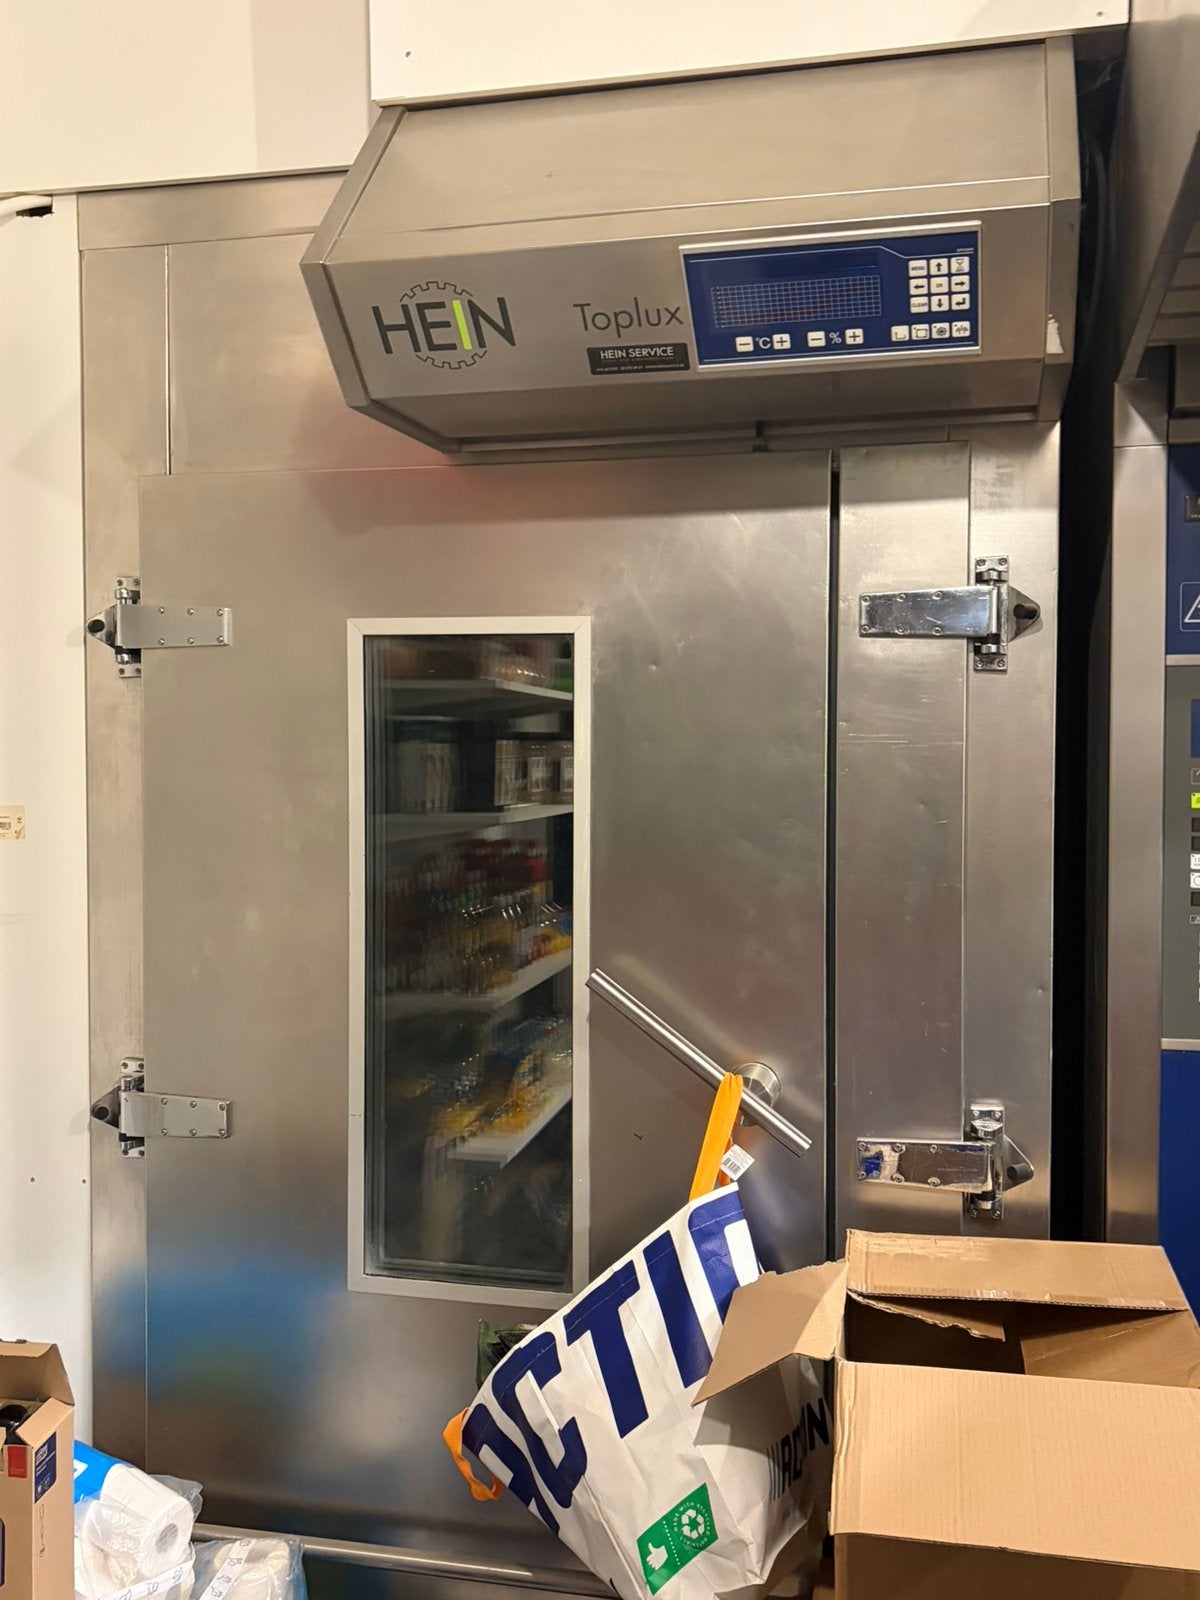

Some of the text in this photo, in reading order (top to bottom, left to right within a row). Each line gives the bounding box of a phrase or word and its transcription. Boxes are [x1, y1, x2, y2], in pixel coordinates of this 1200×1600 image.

[371, 296, 517, 354] HEIN
[572, 297, 684, 339] Toplux
[600, 349, 627, 360] HEIN
[628, 346, 674, 358] SERVICE
